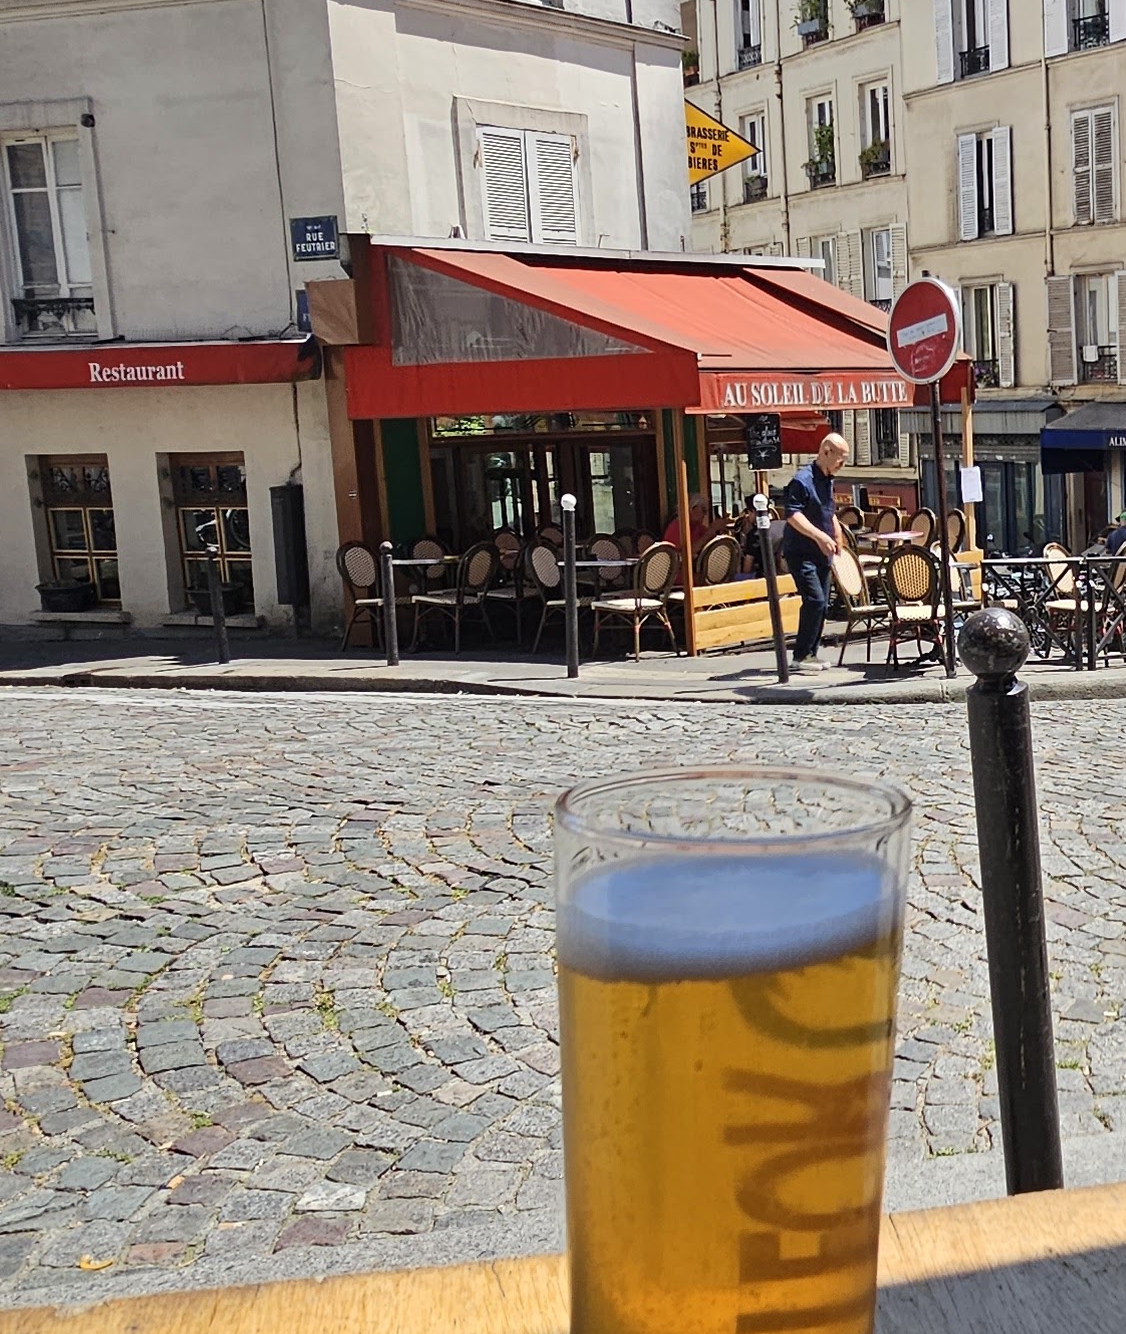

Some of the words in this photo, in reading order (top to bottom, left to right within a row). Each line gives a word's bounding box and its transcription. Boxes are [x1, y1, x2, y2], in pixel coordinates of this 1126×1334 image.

[686, 126, 730, 142] BRASSERIE
[712, 144, 722, 156] DE
[688, 156, 718, 171] BIERES
[306, 232, 324, 242] RUE
[296, 242, 336, 253] FEUTRIER
[88, 361, 185, 382] Restaurant
[724, 383, 746, 407] AU
[751, 382, 806, 406] SOLEIL
[811, 382, 834, 404] DE
[838, 381, 858, 404] LA
[861, 380, 908, 403] BUTTE
